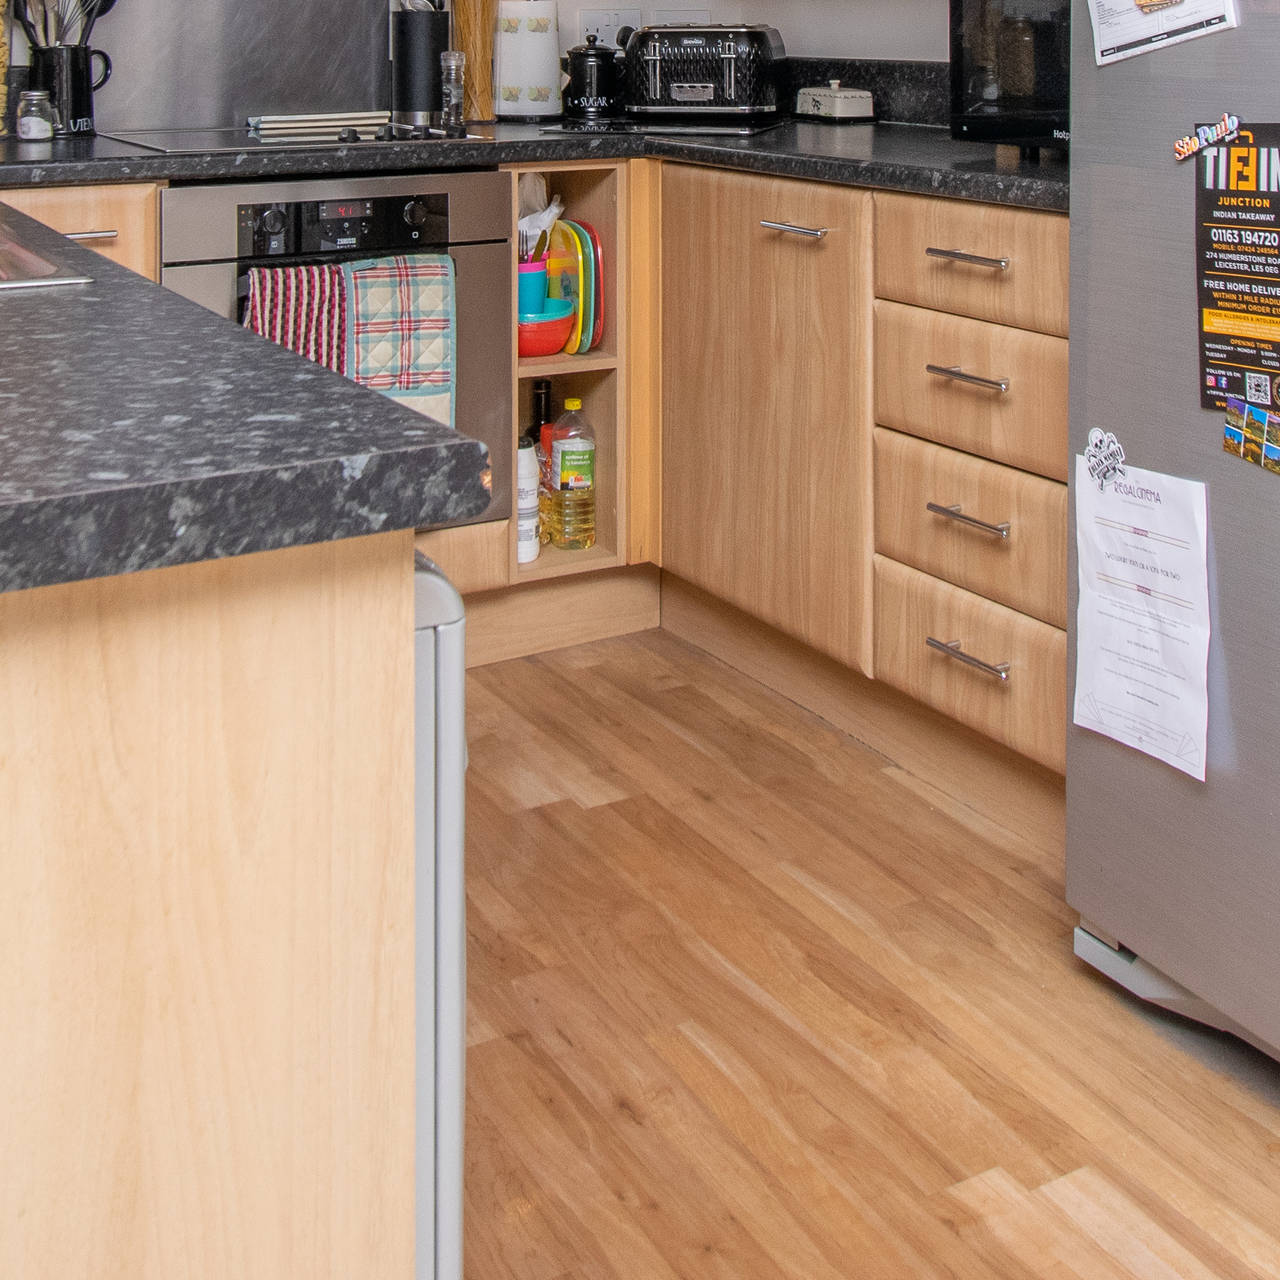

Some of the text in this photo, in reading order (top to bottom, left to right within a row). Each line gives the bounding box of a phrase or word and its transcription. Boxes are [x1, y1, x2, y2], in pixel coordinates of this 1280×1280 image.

[579, 97, 608, 108] SUGAR
[70, 118, 93, 132] UTEN
[1197, 113, 1239, 149] Paulo
[1054, 130, 1070, 142] Hotp
[1218, 196, 1271, 209] JUNCTION
[1213, 210, 1276, 222] INDIAN TAKEAWAY
[1211, 228, 1280, 247] 01163 194720
[1219, 253, 1267, 264] HUMBERSTONE
[1203, 279, 1226, 290] FREE
[1227, 282, 1251, 293] HOME
[1213, 291, 1238, 301] WITHIN
[1244, 295, 1259, 304] MILE
[1218, 301, 1247, 311] MINIMUM
[1248, 304, 1271, 314] ORDER
[1230, 339, 1273, 351] OPENING TIMES
